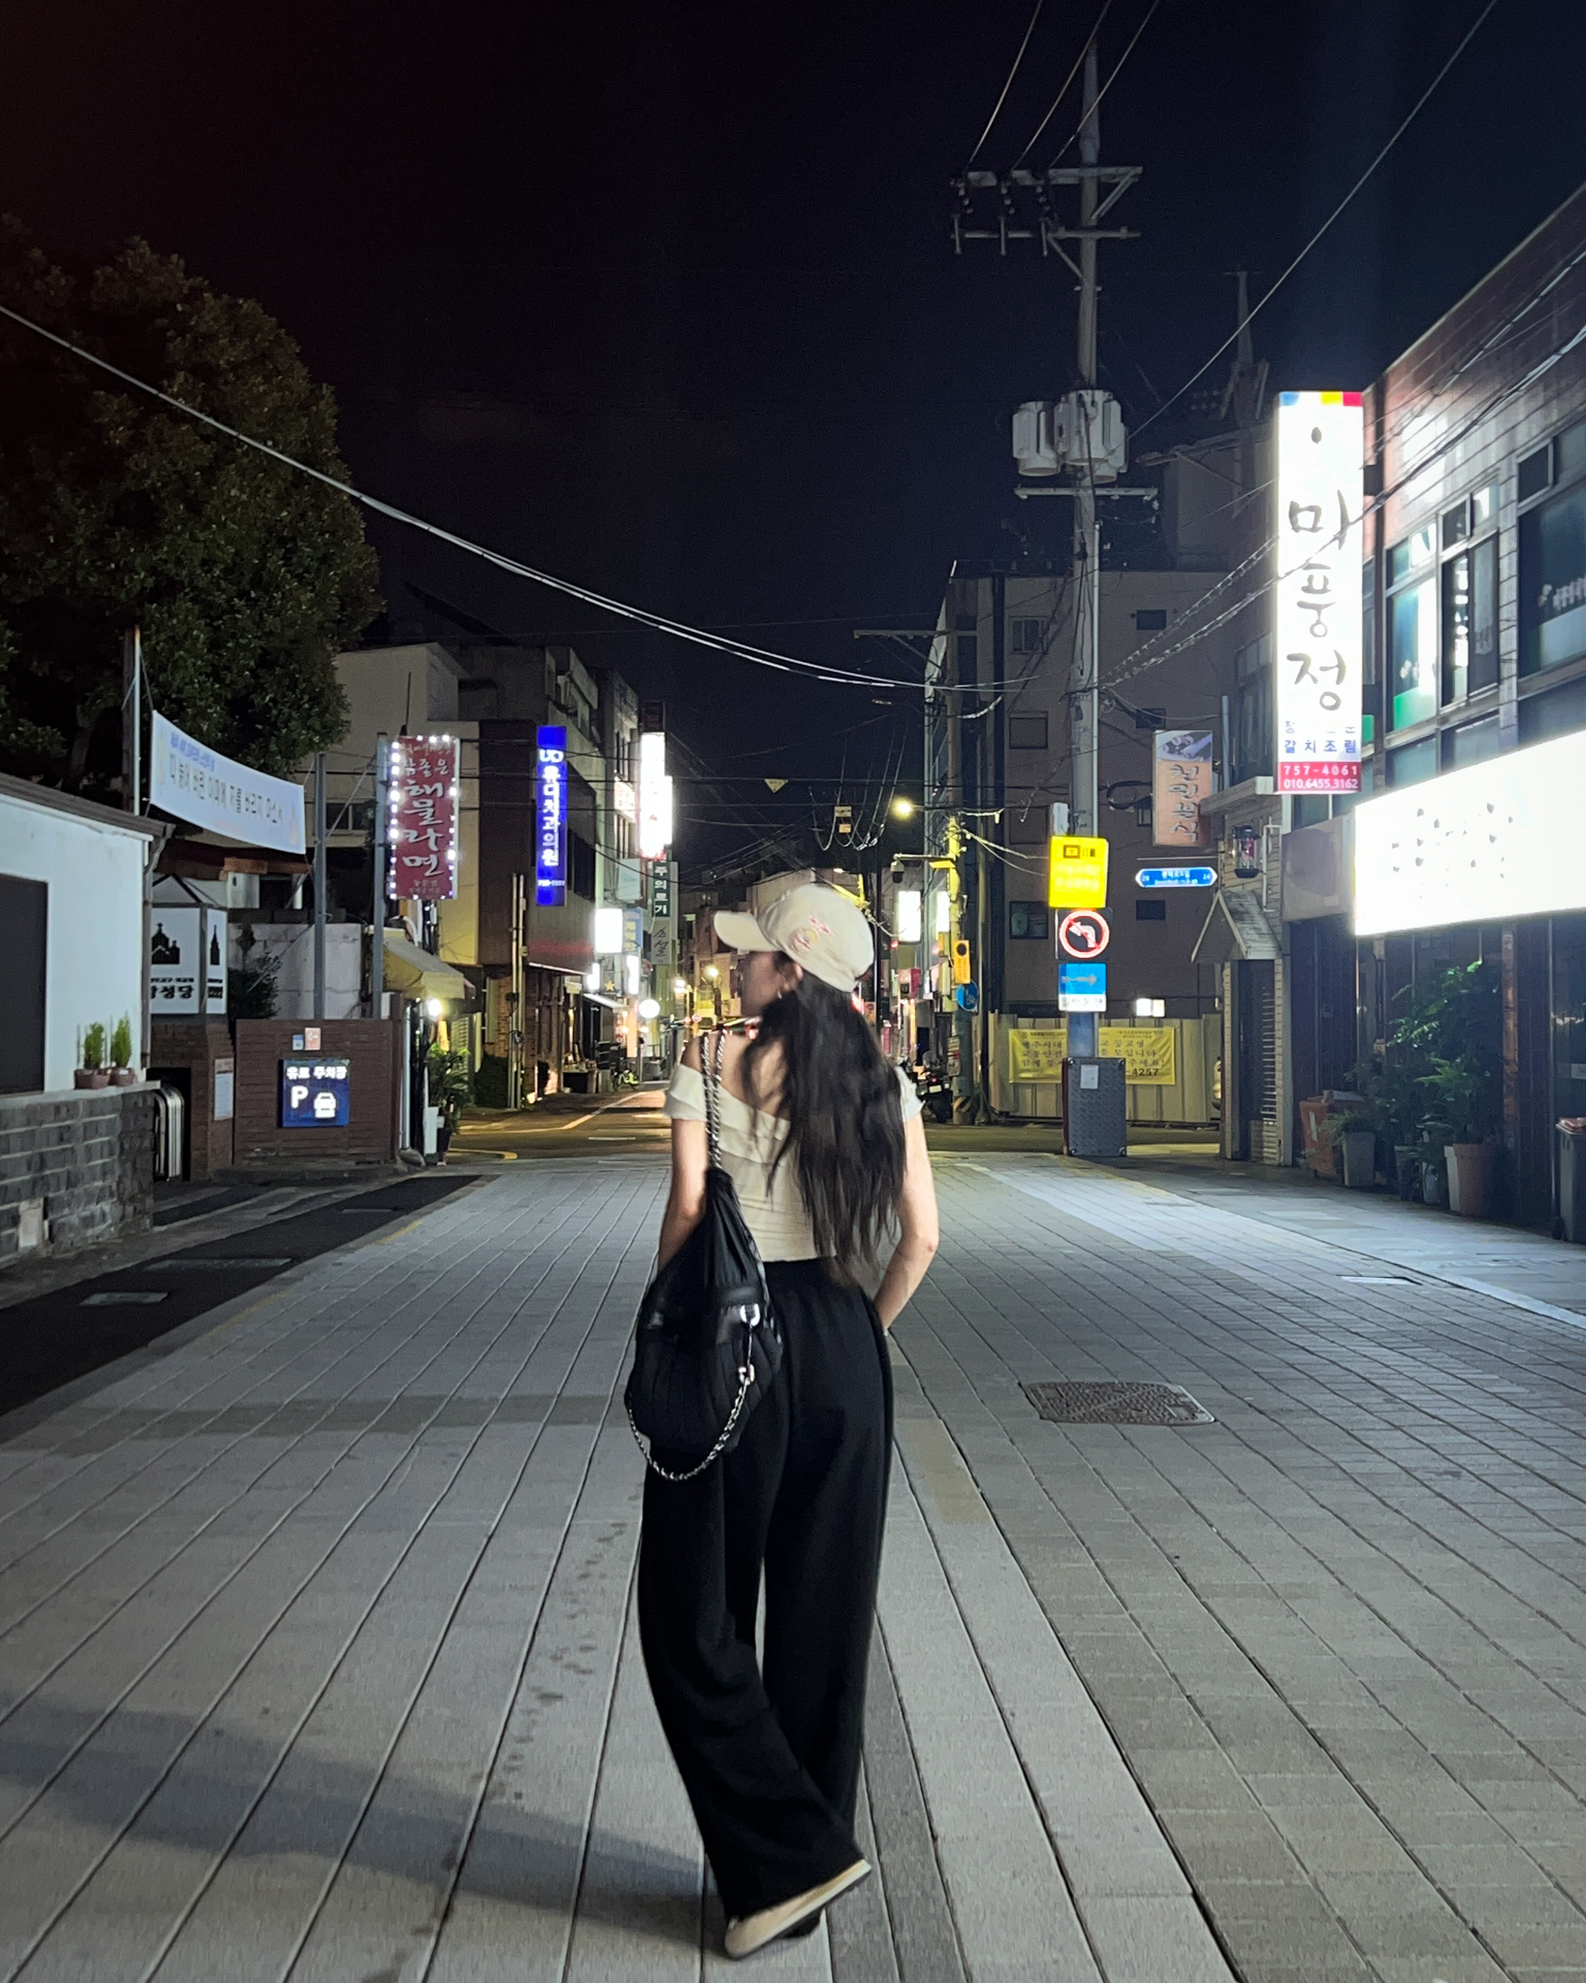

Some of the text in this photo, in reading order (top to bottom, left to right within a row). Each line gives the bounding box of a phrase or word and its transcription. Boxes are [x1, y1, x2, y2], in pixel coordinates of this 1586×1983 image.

[1284, 739, 1356, 754] 갈치조림
[1283, 765, 1358, 776] 757-4061
[402, 779, 444, 877] 해물라면
[654, 860, 669, 915] 주의료기
[286, 1065, 348, 1080] 유료 주차장
[291, 1085, 309, 1109] P
